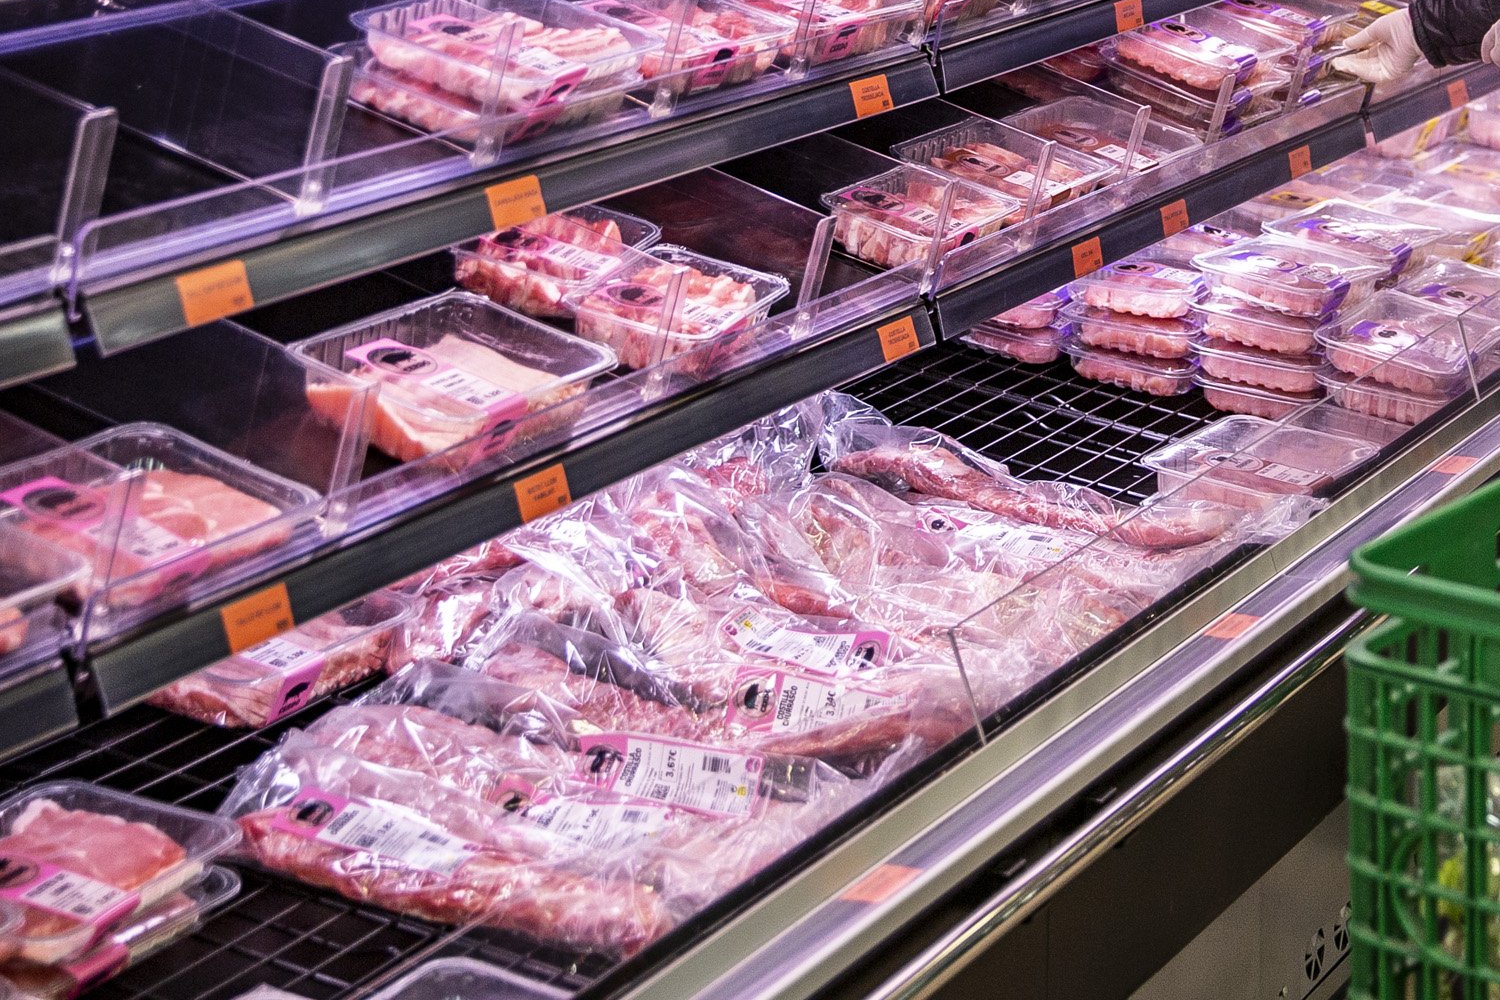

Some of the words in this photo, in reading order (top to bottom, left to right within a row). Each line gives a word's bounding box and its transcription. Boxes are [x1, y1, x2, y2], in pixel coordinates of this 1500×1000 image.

[776, 689, 791, 720] COSTILLA
[782, 685, 799, 727] CHURRASCO
[619, 752, 636, 781] COSTILLA
[624, 747, 643, 788] CHURRASCO
[665, 749, 678, 778] 3,67€
